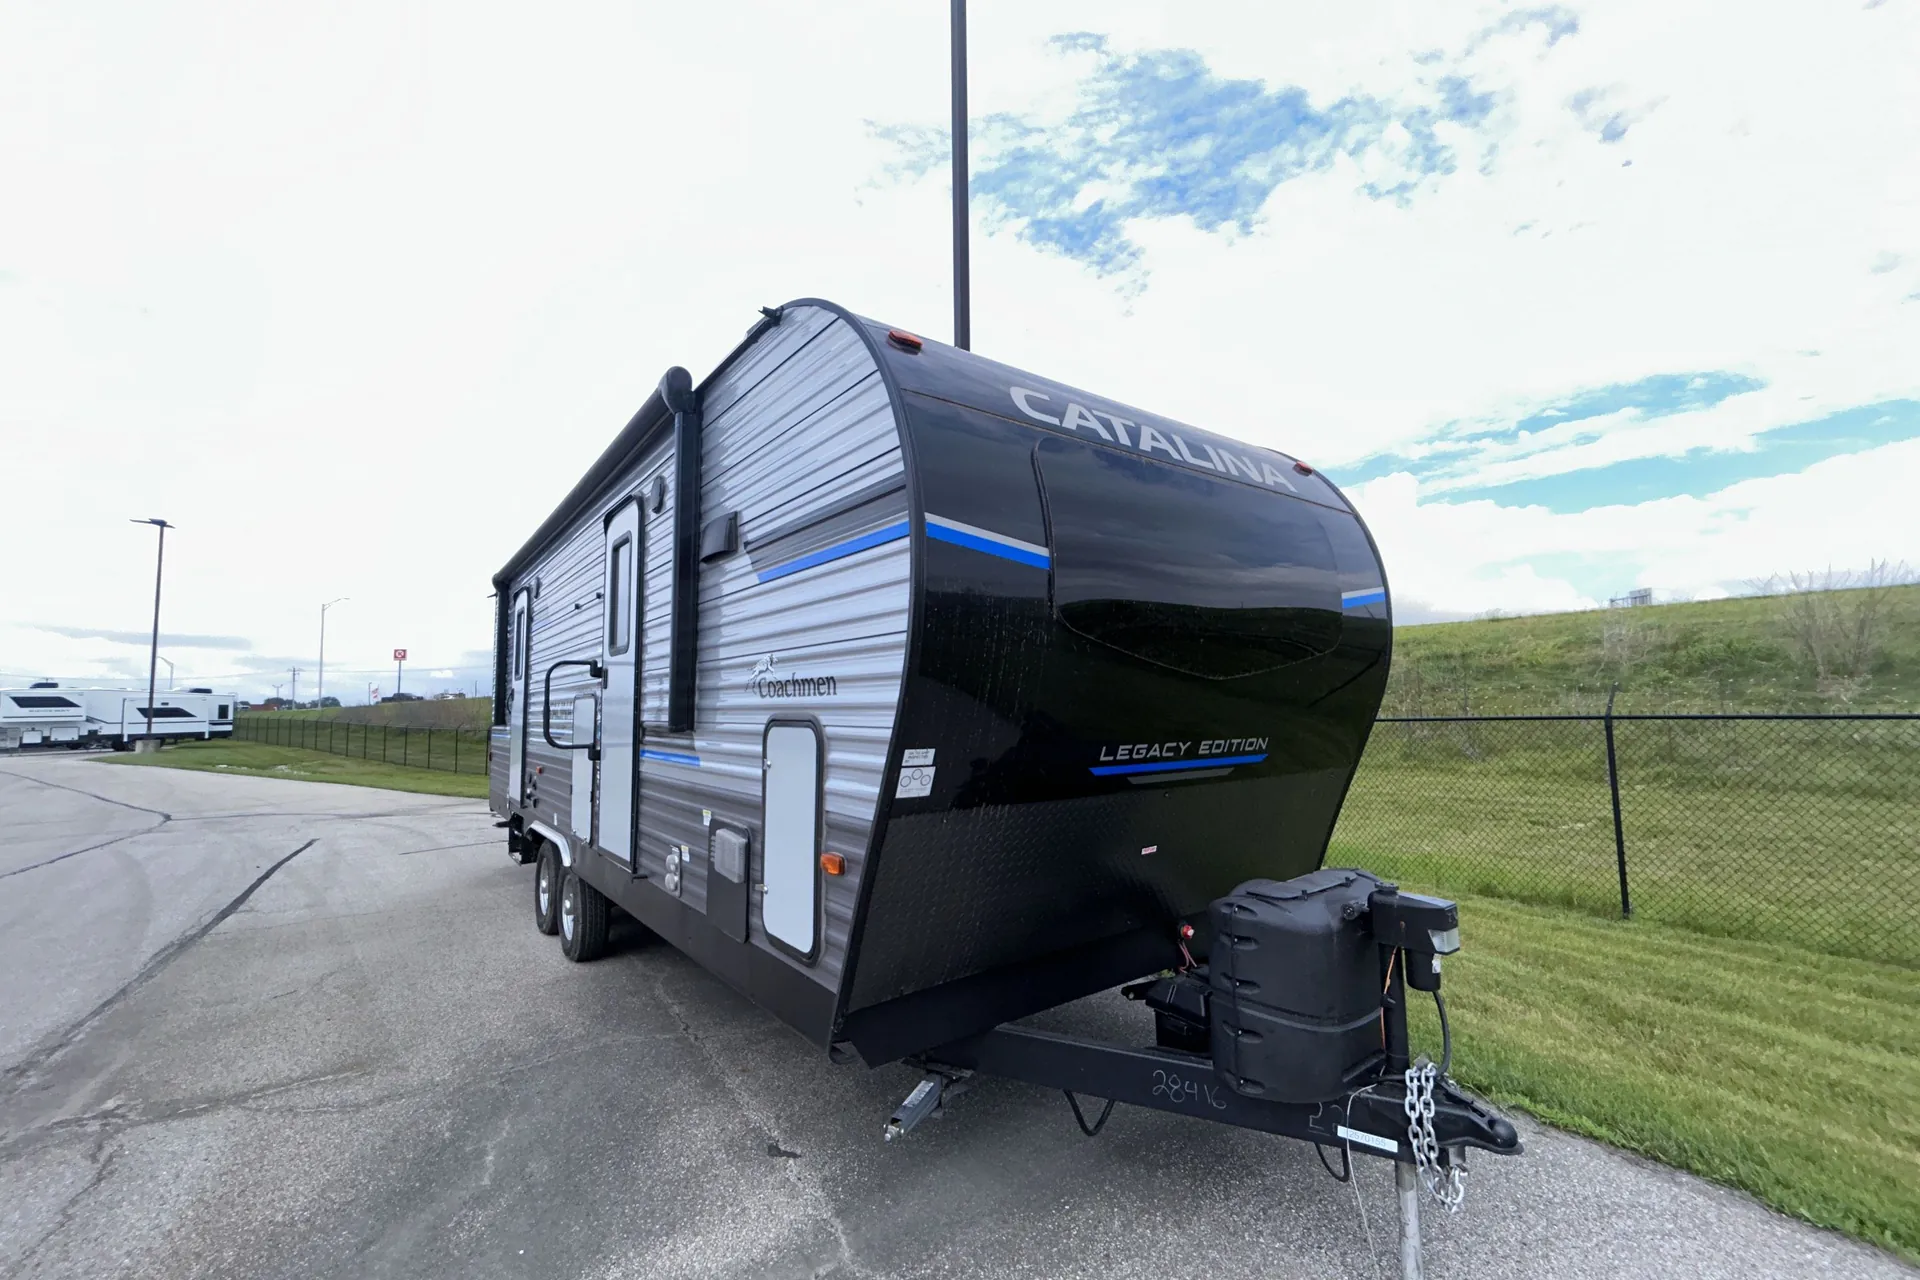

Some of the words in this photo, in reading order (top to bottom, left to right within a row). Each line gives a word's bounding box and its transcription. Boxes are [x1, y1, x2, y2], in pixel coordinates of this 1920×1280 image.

[1009, 386, 1298, 492] CATALINA
[758, 672, 837, 699] Coachmen
[1100, 741, 1191, 761] LEGACY
[1198, 737, 1269, 755] EDITION
